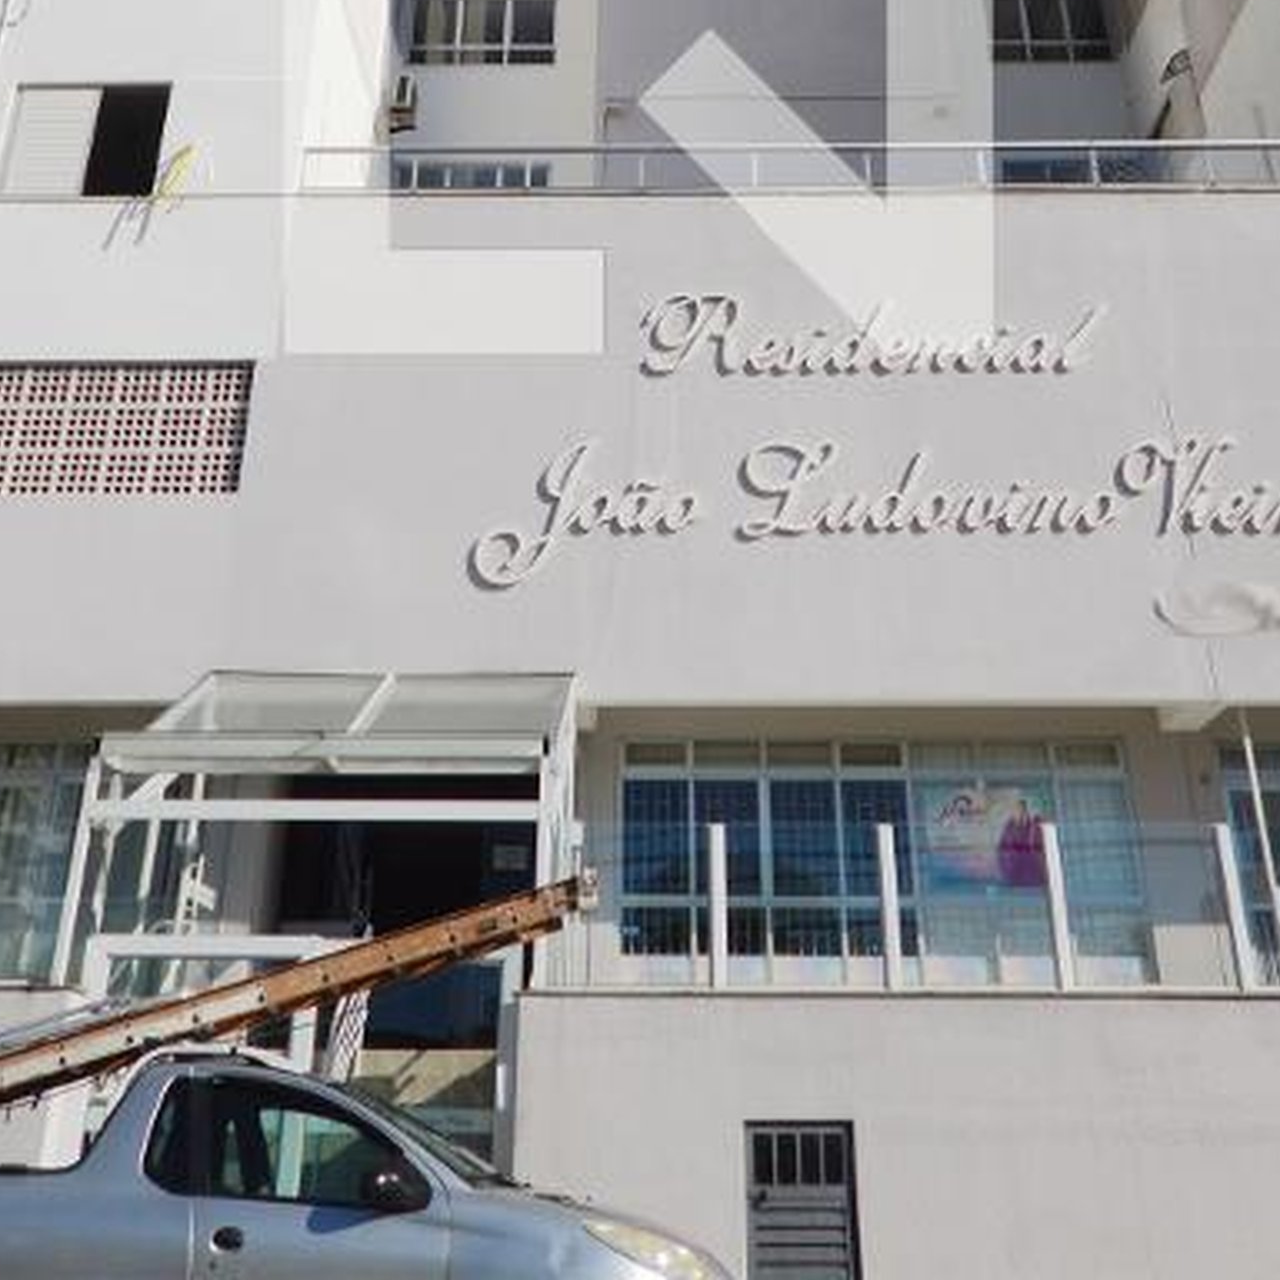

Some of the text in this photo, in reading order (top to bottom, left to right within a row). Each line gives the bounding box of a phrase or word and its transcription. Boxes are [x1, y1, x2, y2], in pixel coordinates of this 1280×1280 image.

[638, 293, 1104, 376] Residencial
[466, 442, 696, 591] João
[734, 443, 1116, 542] Ludovino
